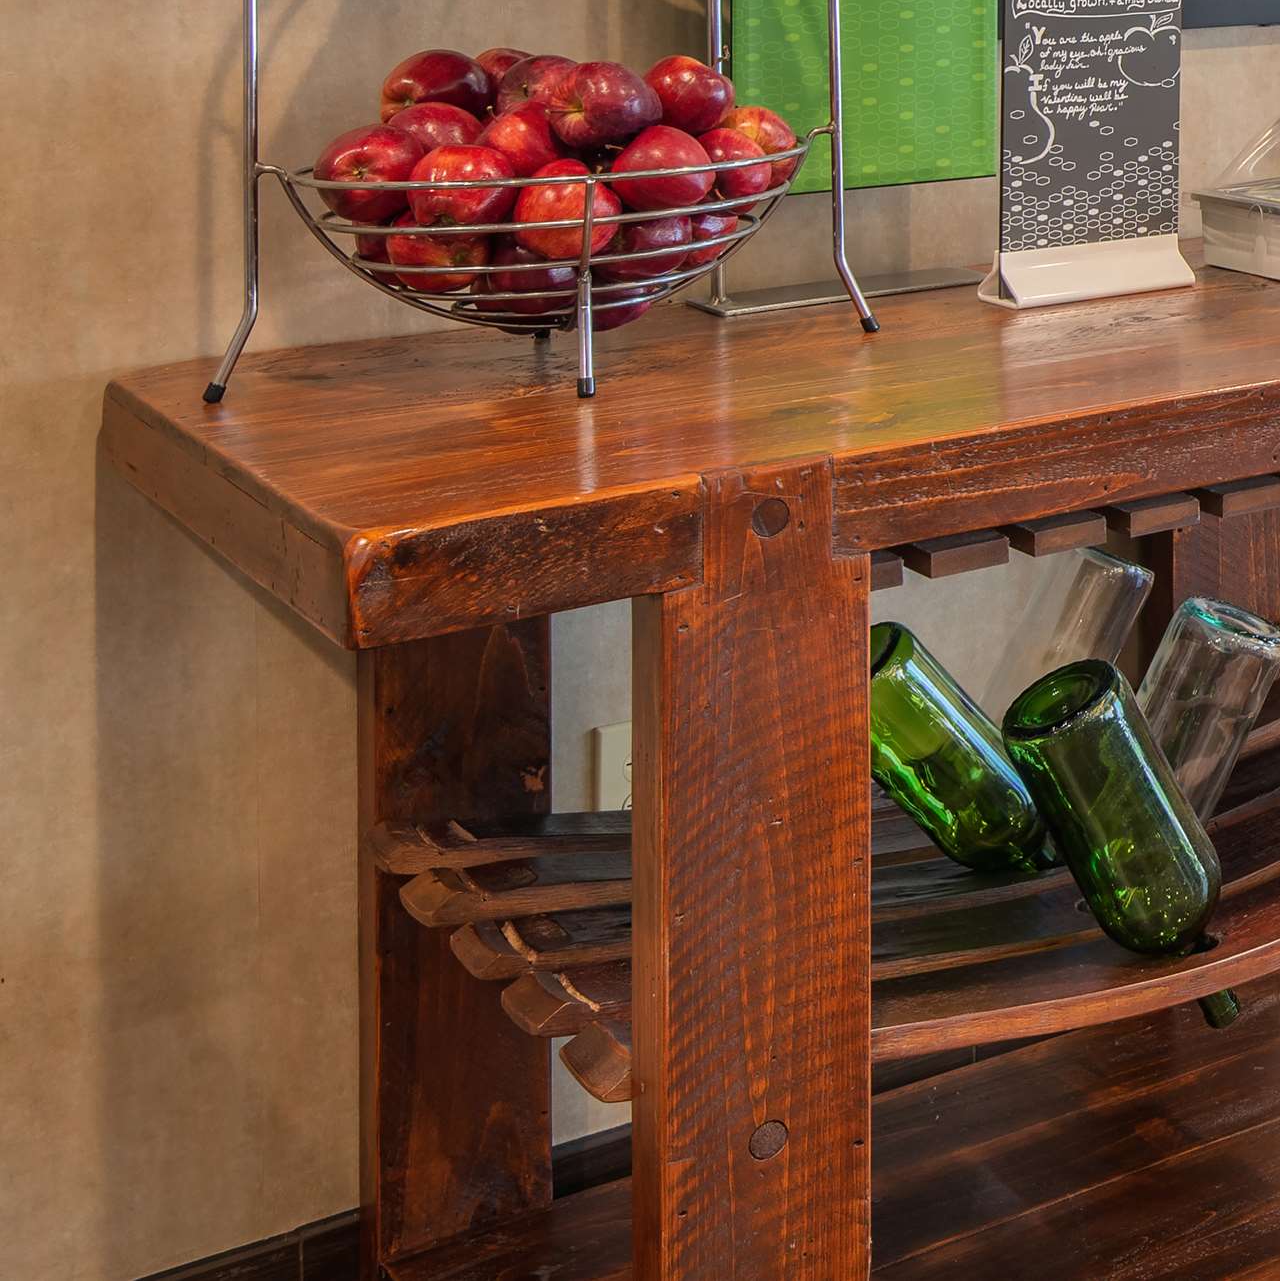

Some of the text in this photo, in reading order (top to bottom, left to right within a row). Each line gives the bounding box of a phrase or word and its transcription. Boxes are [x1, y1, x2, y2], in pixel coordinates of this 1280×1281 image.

[1059, 36, 1078, 45] are
[1079, 31, 1098, 43] the
[1098, 29, 1123, 45] apple
[1040, 46, 1053, 58] of
[1052, 49, 1068, 63] my
[1039, 58, 1066, 79] lady
[1028, 74, 1129, 96] If you will be my
[1112, 89, 1129, 101] be
[1043, 106, 1054, 114] a
[1056, 104, 1089, 121] happy
